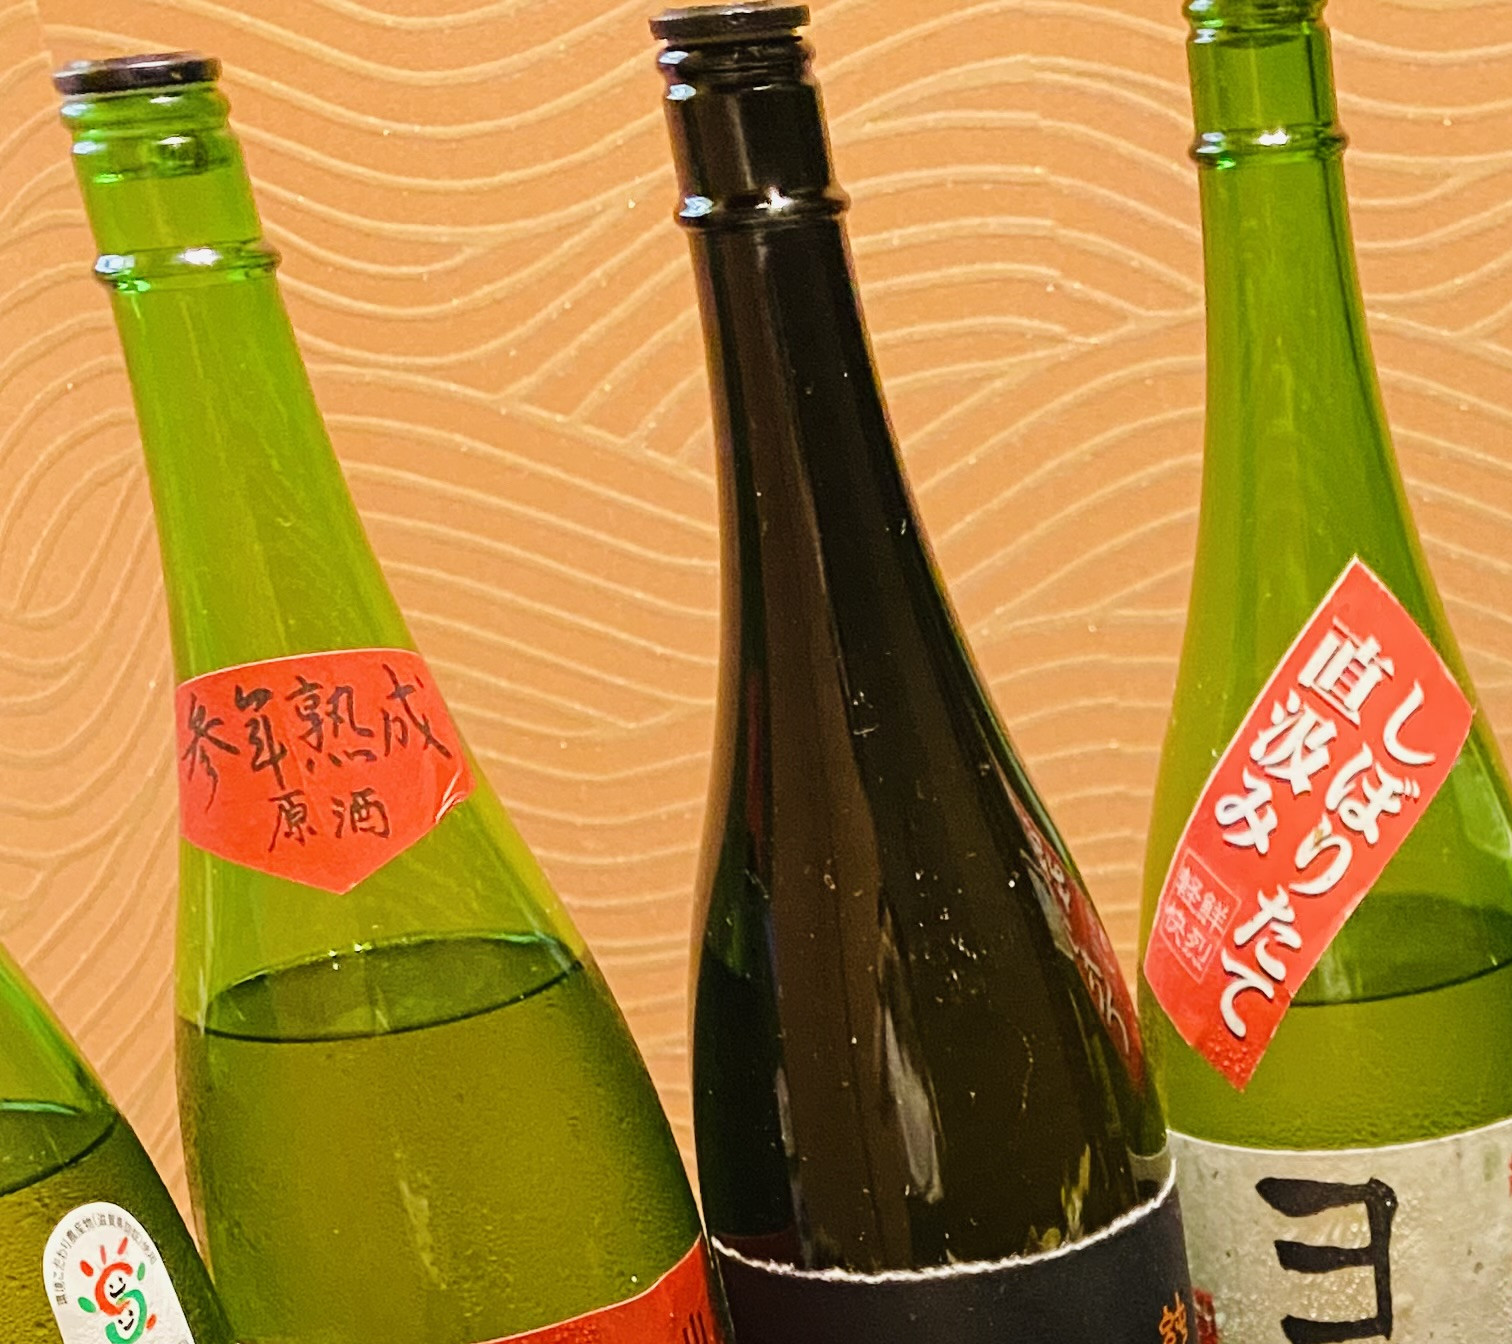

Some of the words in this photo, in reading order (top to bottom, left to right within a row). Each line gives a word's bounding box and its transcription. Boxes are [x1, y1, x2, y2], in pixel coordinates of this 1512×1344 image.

[268, 788, 392, 855] 原酒
[1214, 616, 1394, 855] 直汲み
[1219, 679, 1436, 1039] しぼりたて
